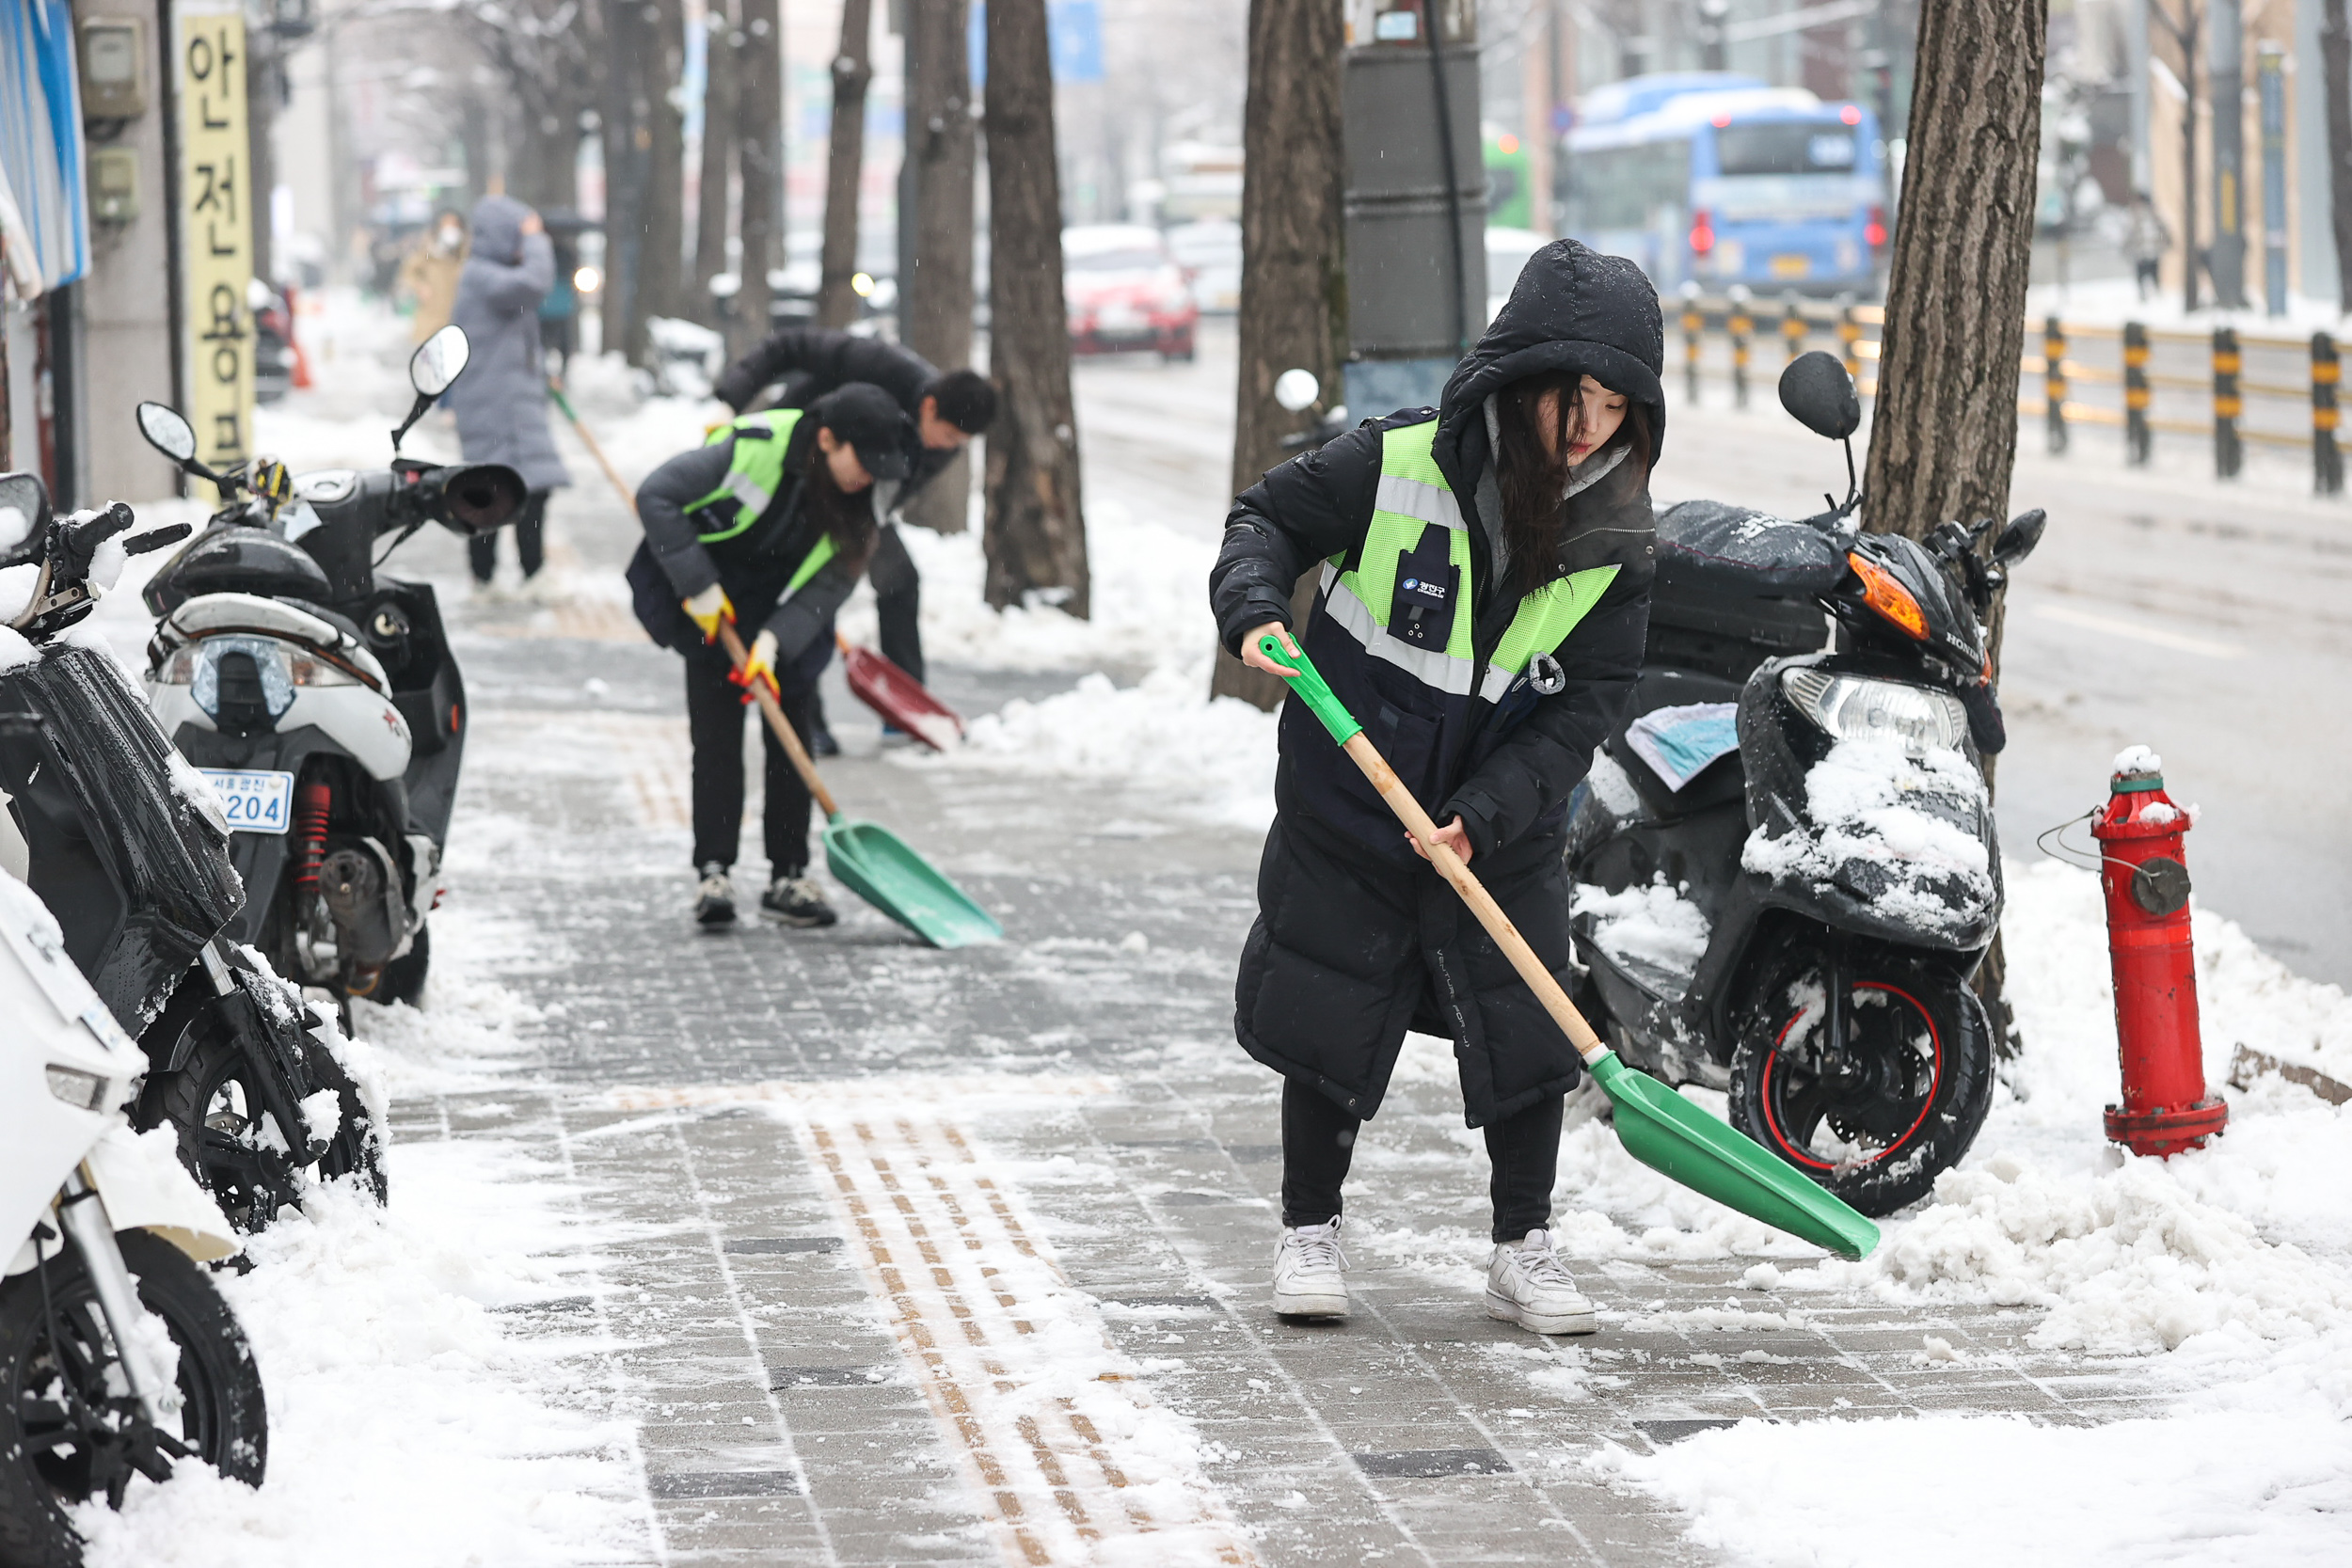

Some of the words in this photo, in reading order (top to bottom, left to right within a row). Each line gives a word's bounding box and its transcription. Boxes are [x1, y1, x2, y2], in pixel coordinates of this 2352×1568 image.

[1419, 580, 1446, 594] 광진구
[214, 777, 235, 789] 서울
[219, 794, 279, 821] 204
